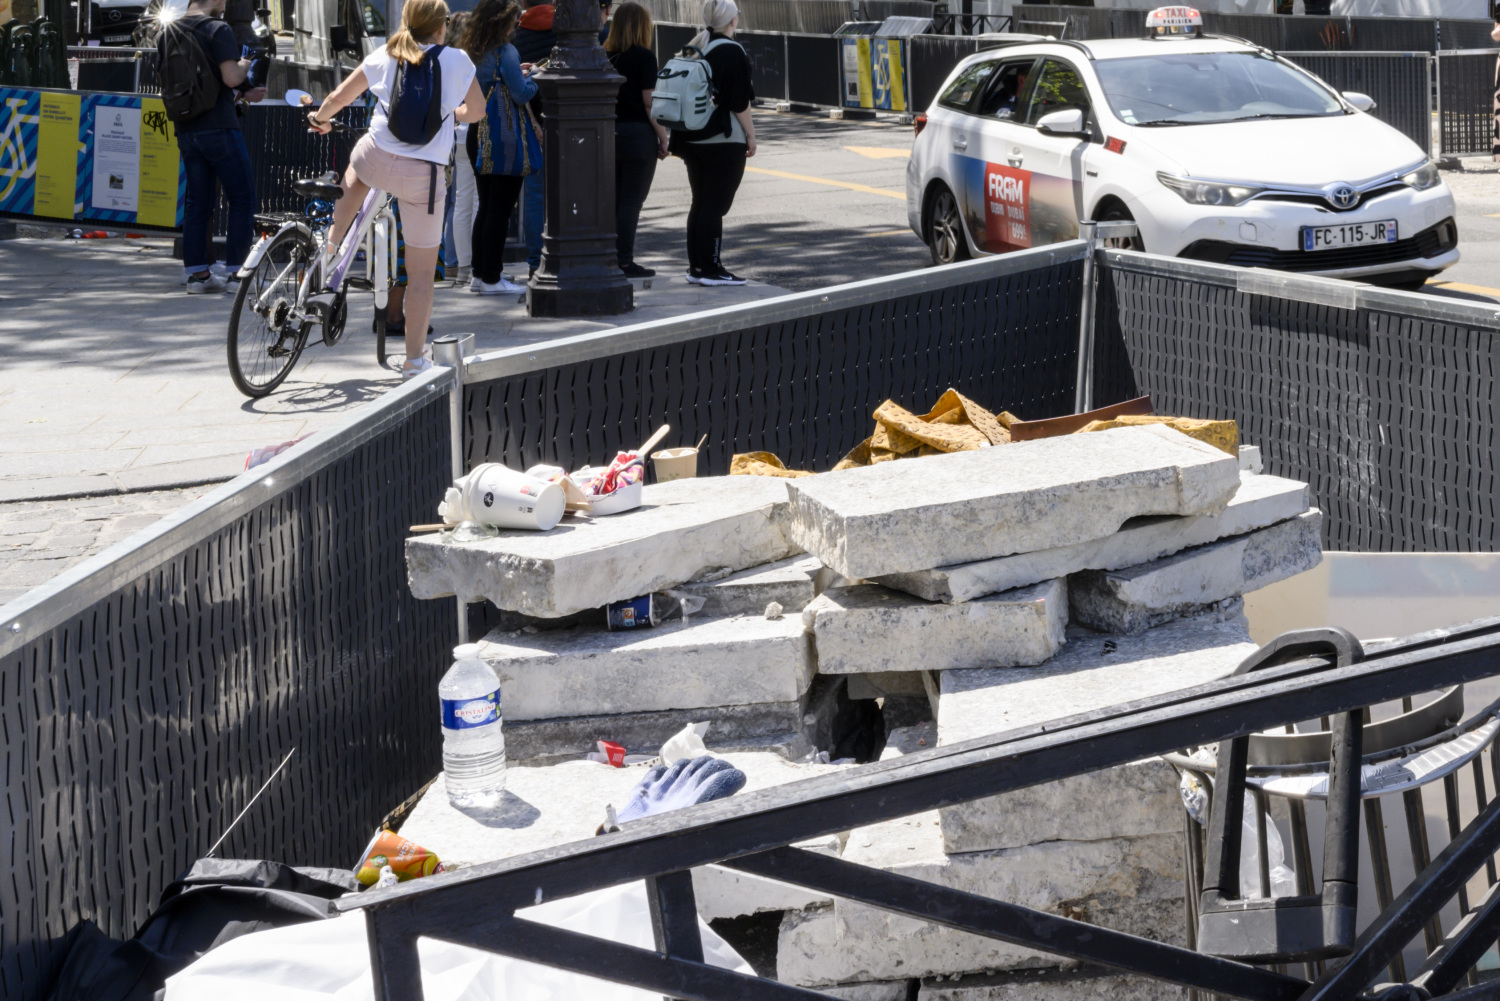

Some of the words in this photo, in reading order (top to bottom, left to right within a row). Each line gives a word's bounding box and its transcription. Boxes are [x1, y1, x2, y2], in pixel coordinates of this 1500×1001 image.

[1164, 8, 1187, 18] TAXI
[989, 173, 1024, 205] FRAM
[1315, 223, 1386, 246] FC-115-JR
